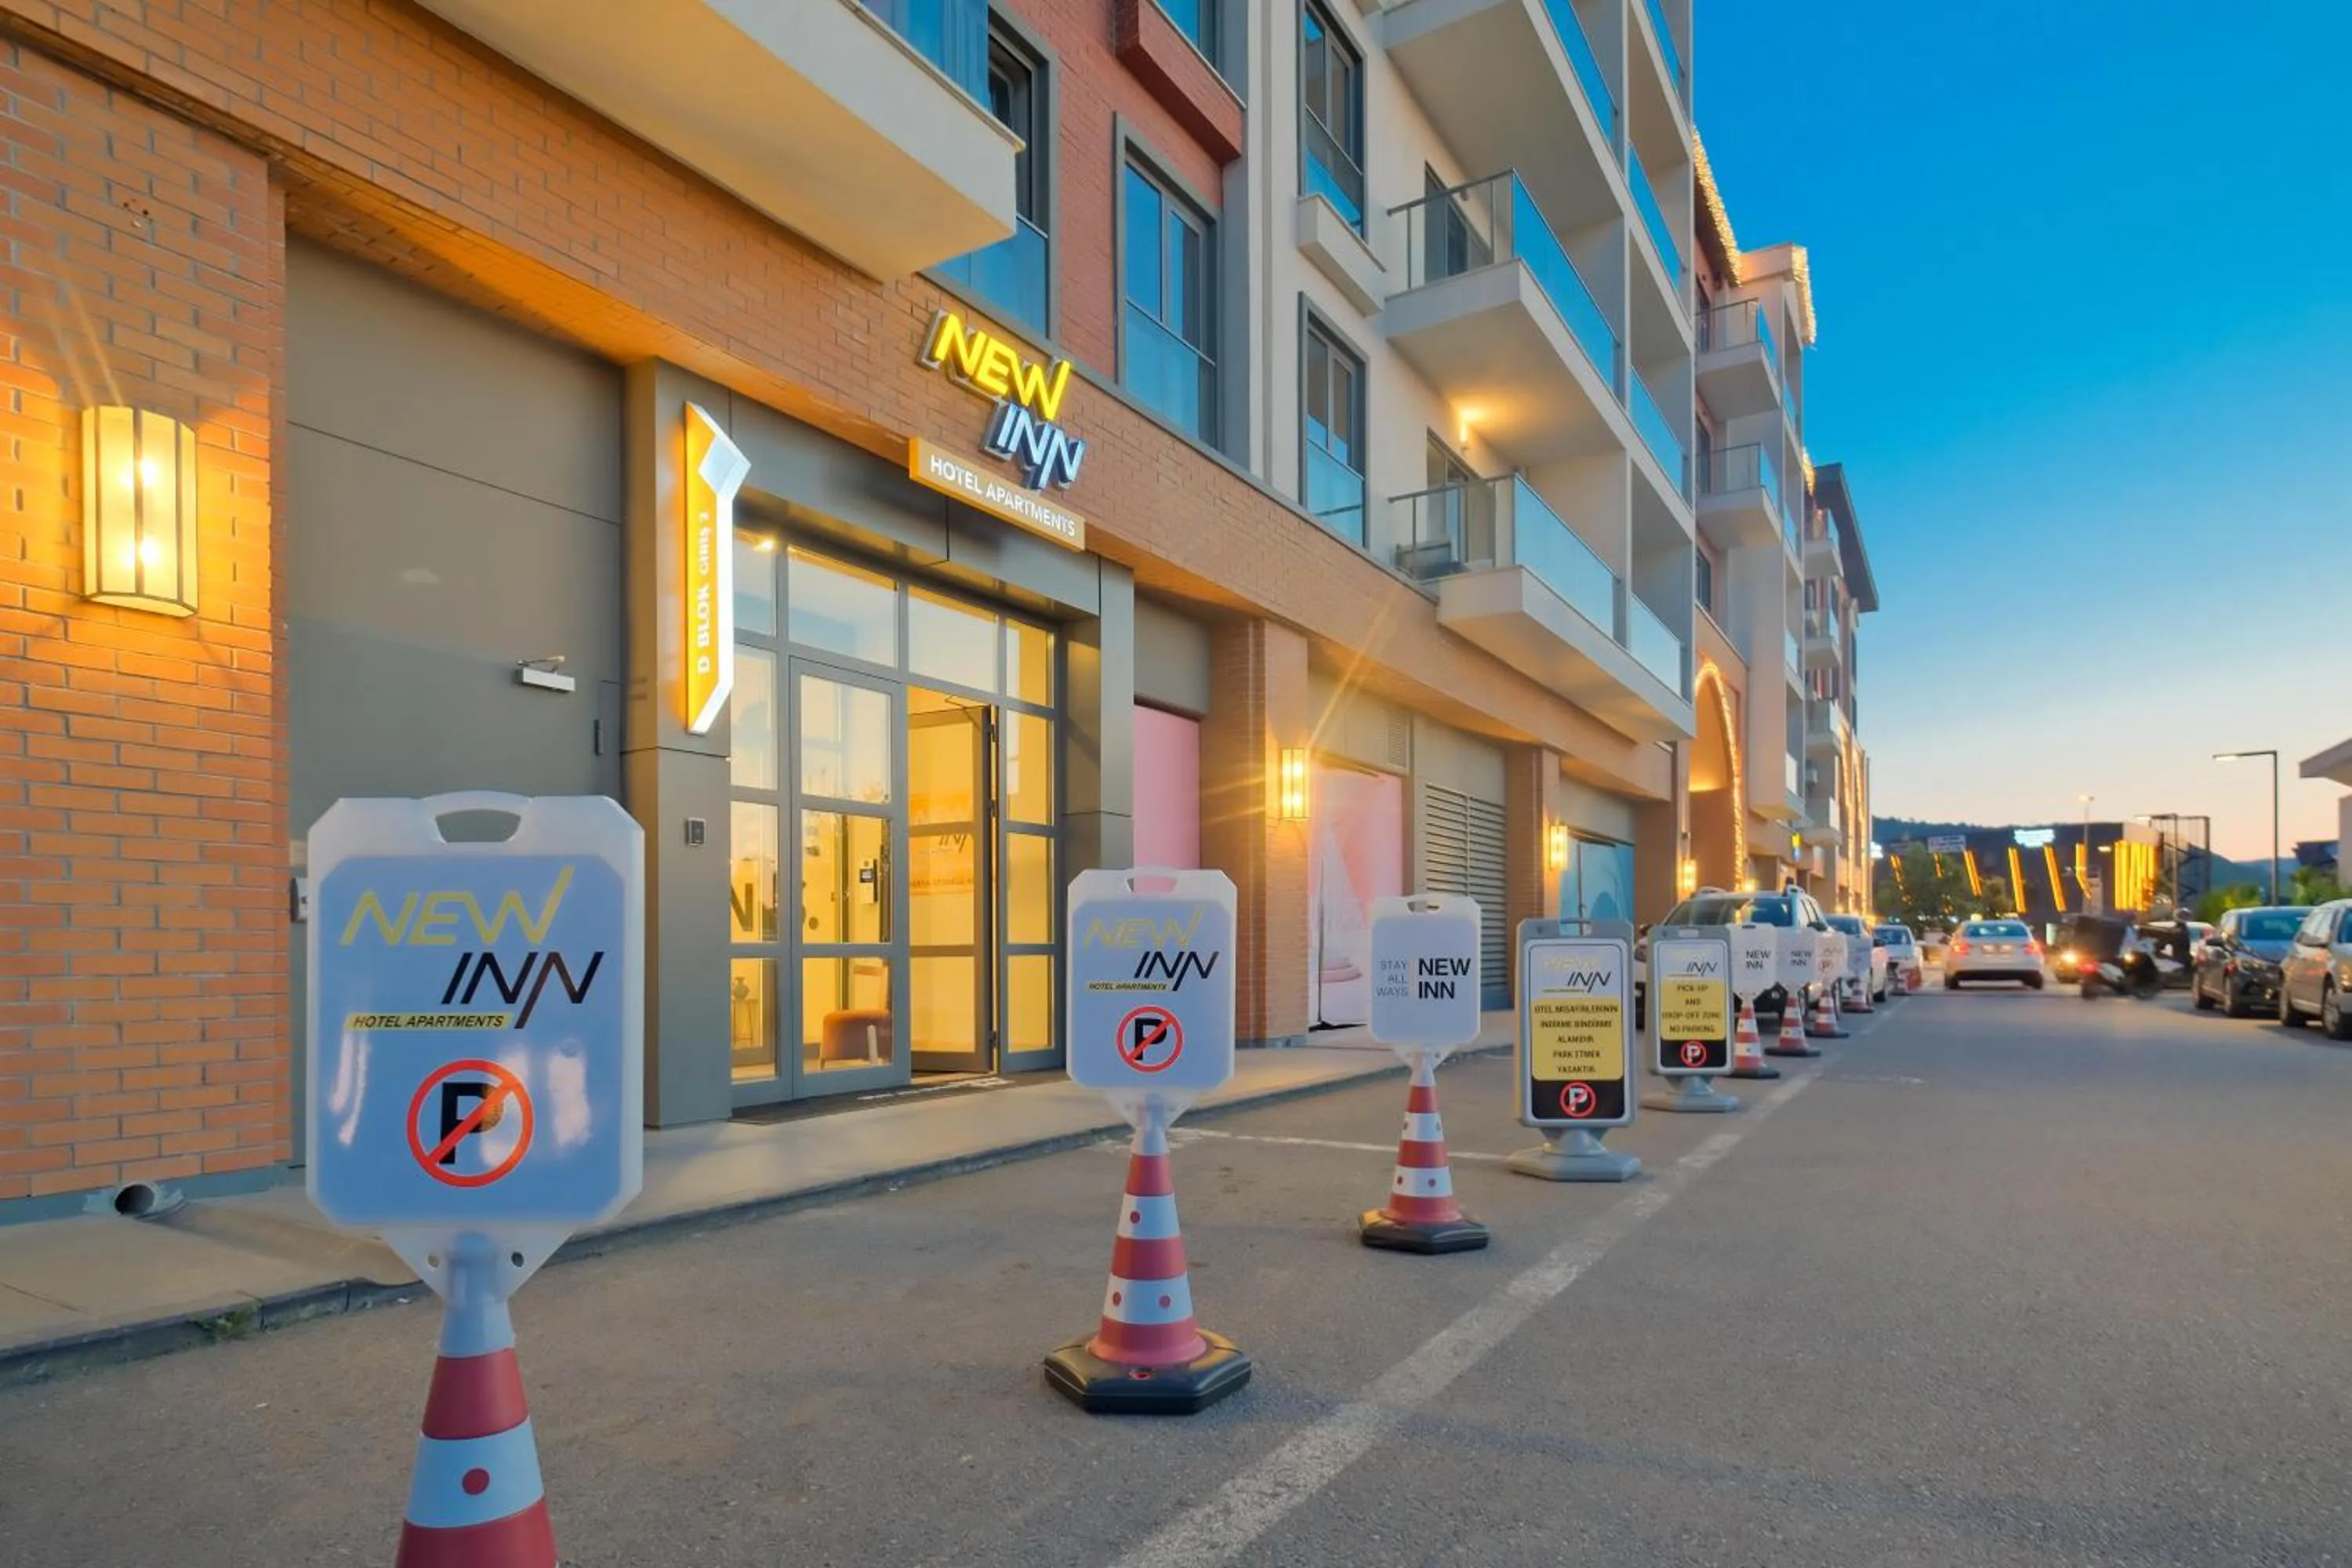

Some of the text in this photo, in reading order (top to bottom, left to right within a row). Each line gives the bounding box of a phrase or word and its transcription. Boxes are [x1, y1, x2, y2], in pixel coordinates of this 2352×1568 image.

[933, 313, 1071, 421] NEW
[996, 401, 1086, 491] INN
[930, 455, 1076, 537] HOTEL APARTMENTS
[697, 584, 710, 648] BLOK
[697, 655, 710, 674] D
[340, 866, 575, 946] NEW
[1082, 906, 1207, 949] NEW
[1746, 949, 1771, 959] NEW
[1134, 951, 1220, 992] INN
[1380, 960, 1408, 970] STAY
[1418, 958, 1471, 976] NEW
[1745, 960, 1764, 970] INN
[1388, 975, 1408, 984] ALL
[1567, 971, 1612, 993] INN
[441, 951, 604, 1029] INN
[1376, 987, 1408, 996] WAYS
[1418, 981, 1455, 1000] INN
[354, 1015, 504, 1028] HOTEL APARTMENTS
